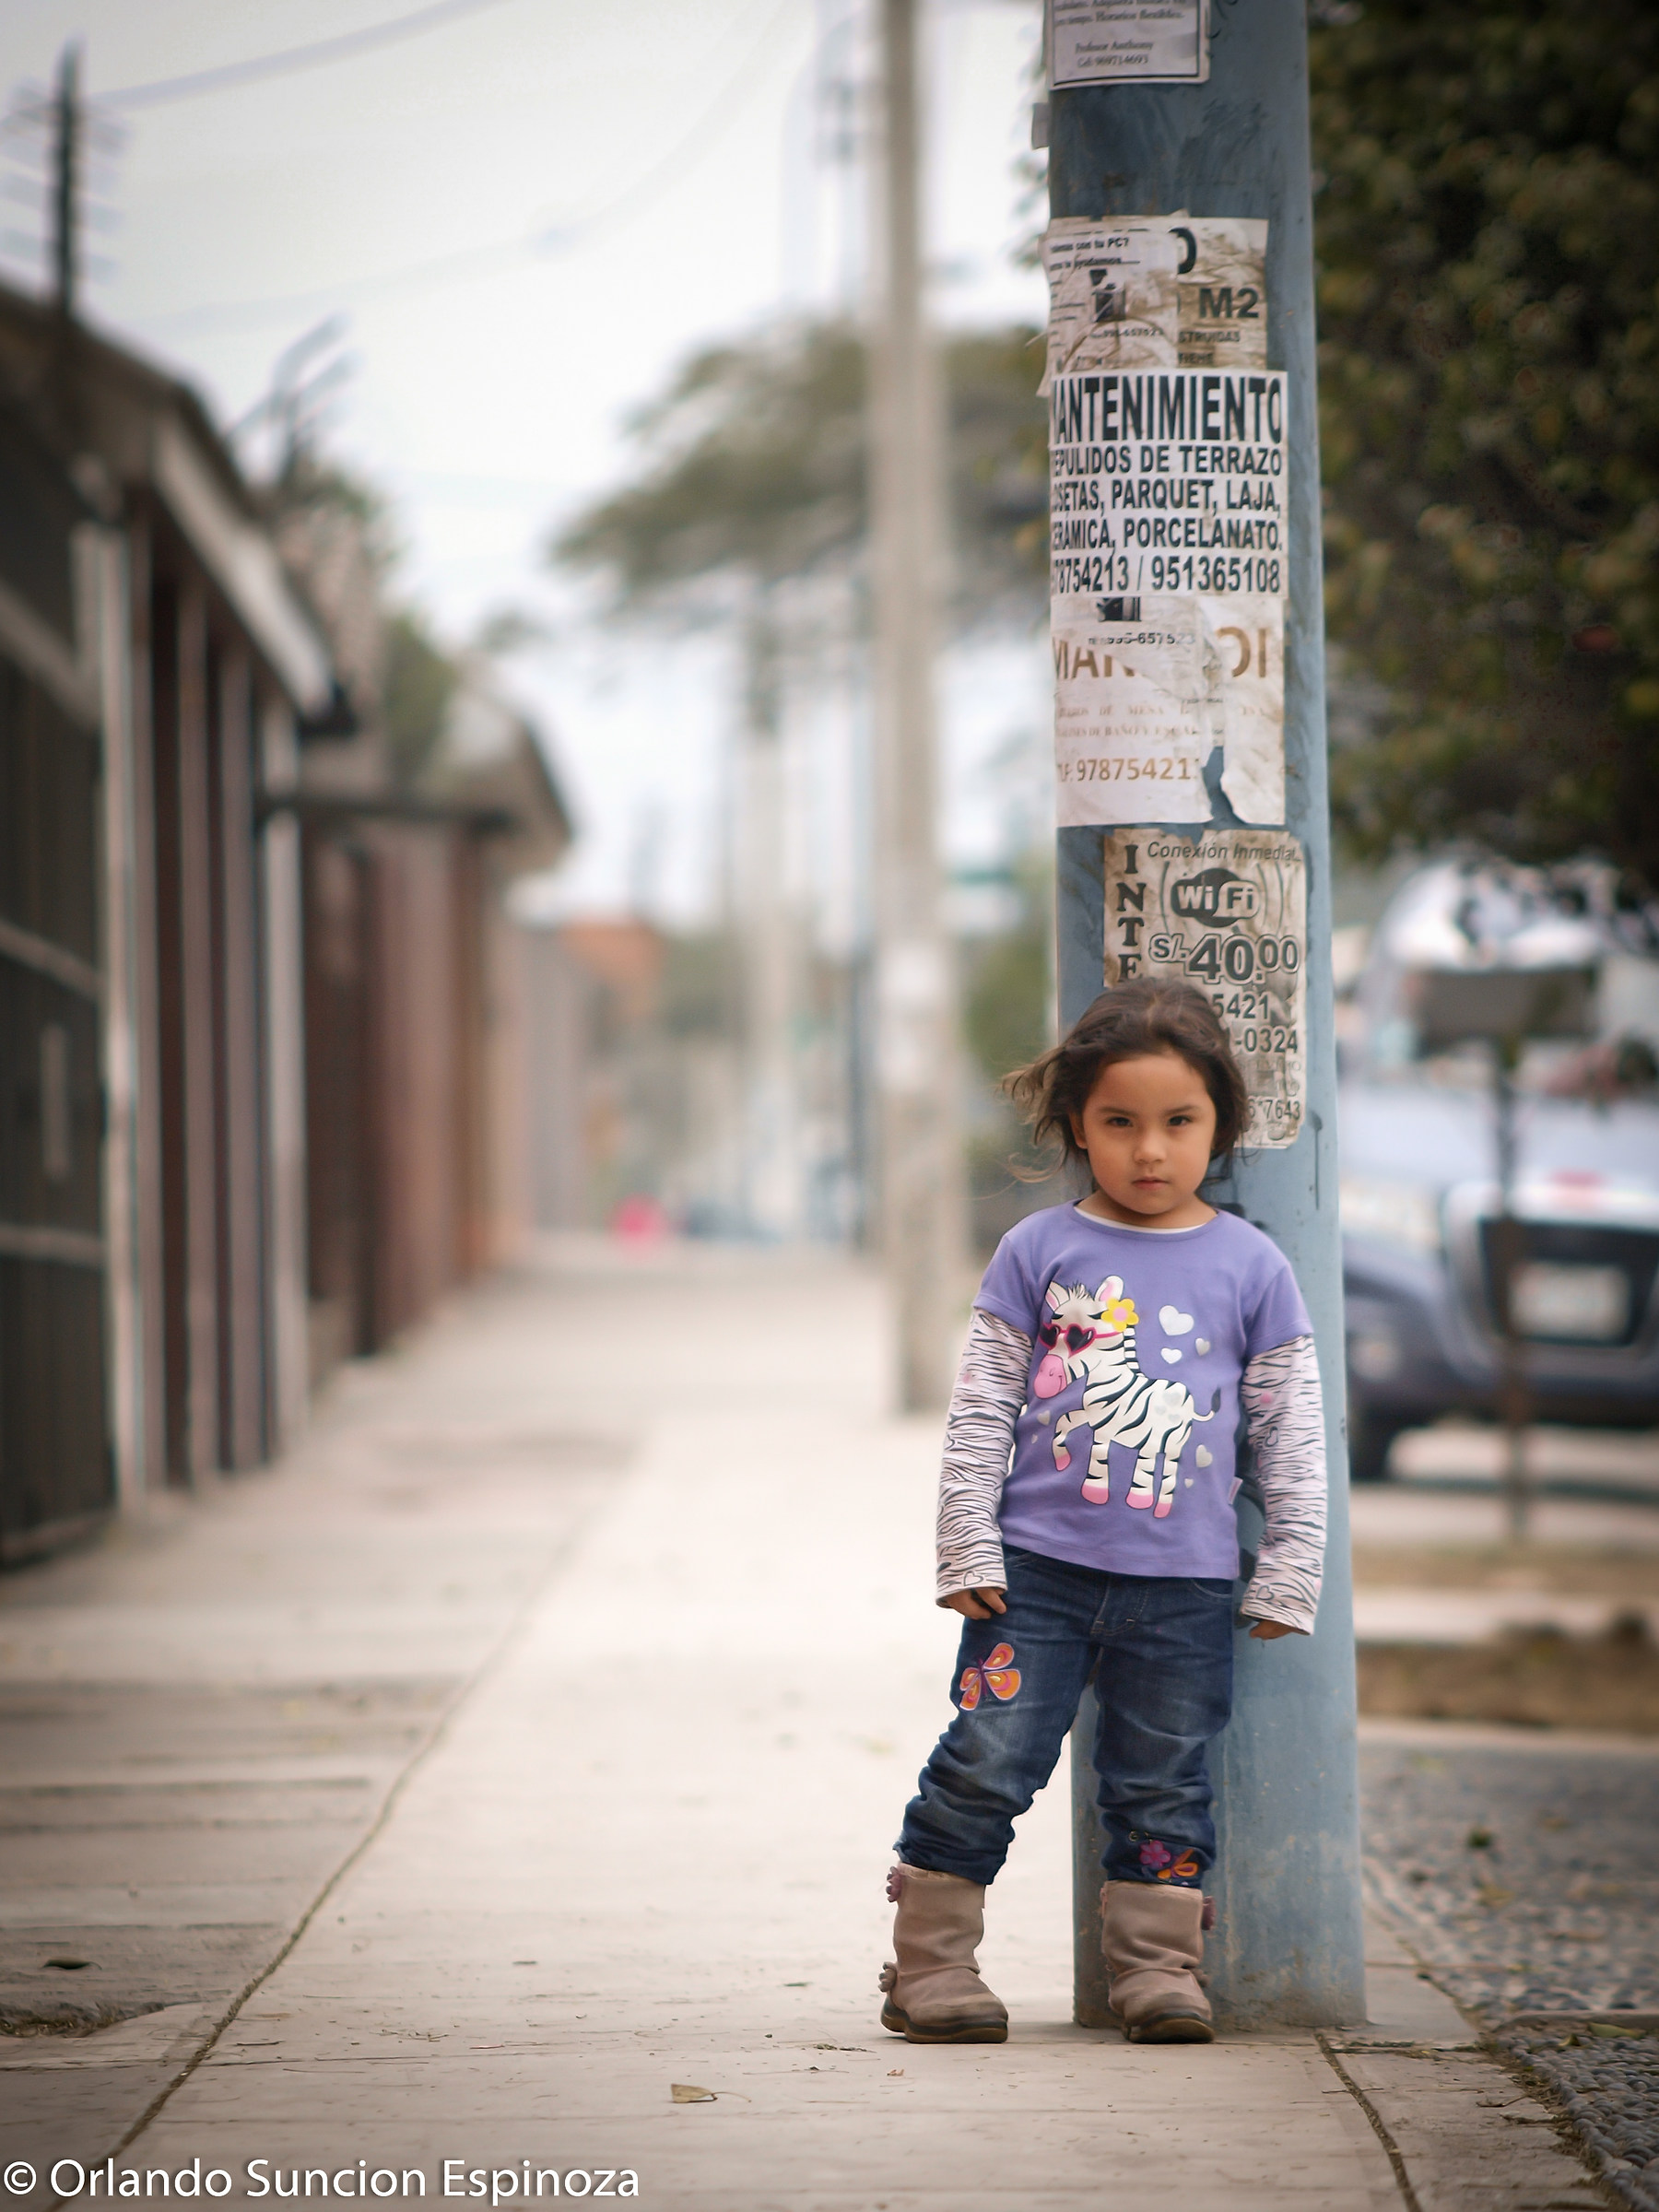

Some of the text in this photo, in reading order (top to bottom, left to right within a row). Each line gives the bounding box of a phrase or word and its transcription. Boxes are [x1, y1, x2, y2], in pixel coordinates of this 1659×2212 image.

[1199, 287, 1260, 319] M2
[1140, 444, 1171, 474] DE
[1178, 445, 1282, 476] TERRAZO
[1112, 478, 1218, 516] PARQUET,
[1227, 479, 1281, 519] LAJA,
[1124, 517, 1283, 551] PORCELANATO.
[1151, 554, 1280, 593] 951365108
[1147, 841, 1228, 858] Conexión
